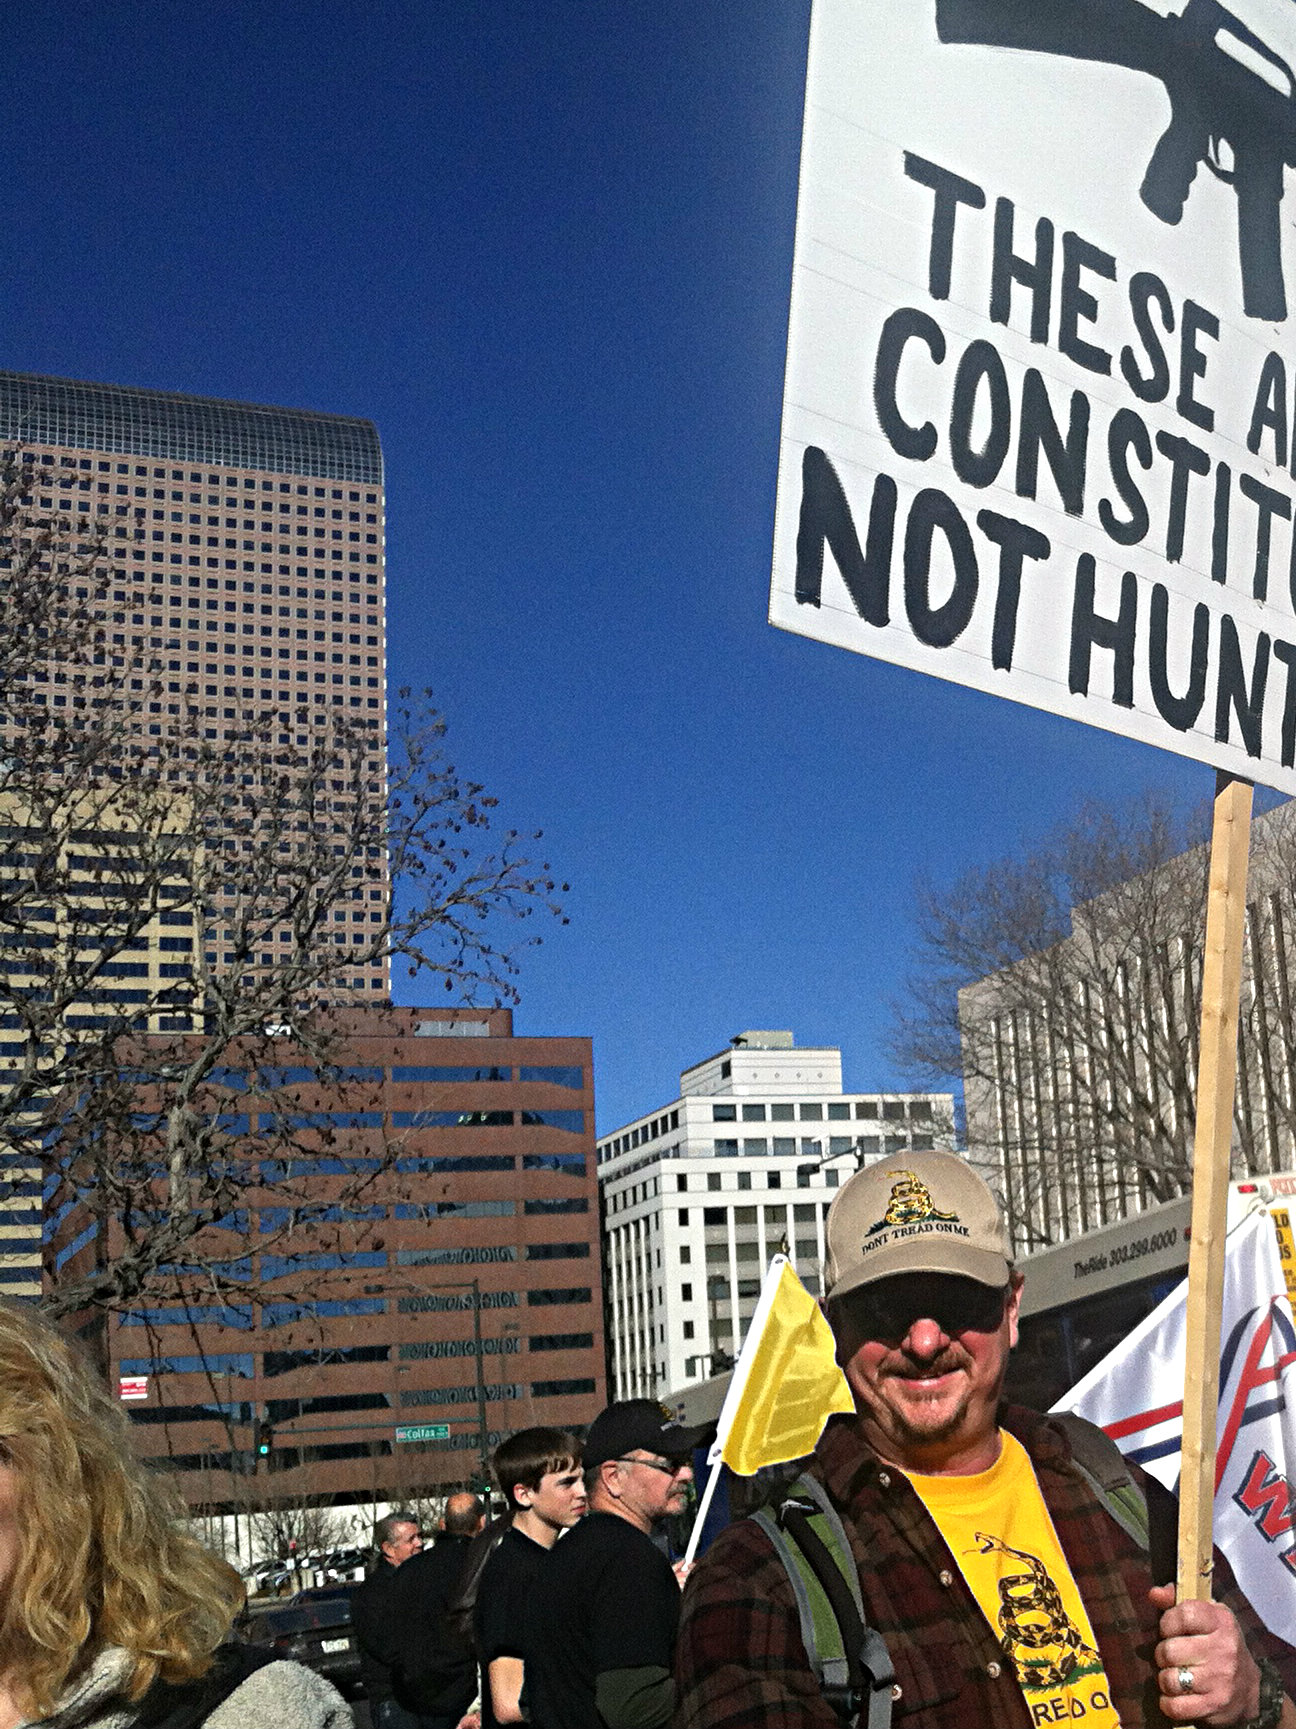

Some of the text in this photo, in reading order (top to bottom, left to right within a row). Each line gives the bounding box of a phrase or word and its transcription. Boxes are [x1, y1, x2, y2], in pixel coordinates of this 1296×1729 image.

[903, 150, 1219, 432] THESE
[796, 445, 1051, 672] NOT
[892, 1223, 933, 1239] TREAD
[936, 1223, 952, 1233] ON
[952, 1223, 970, 1237] ME
